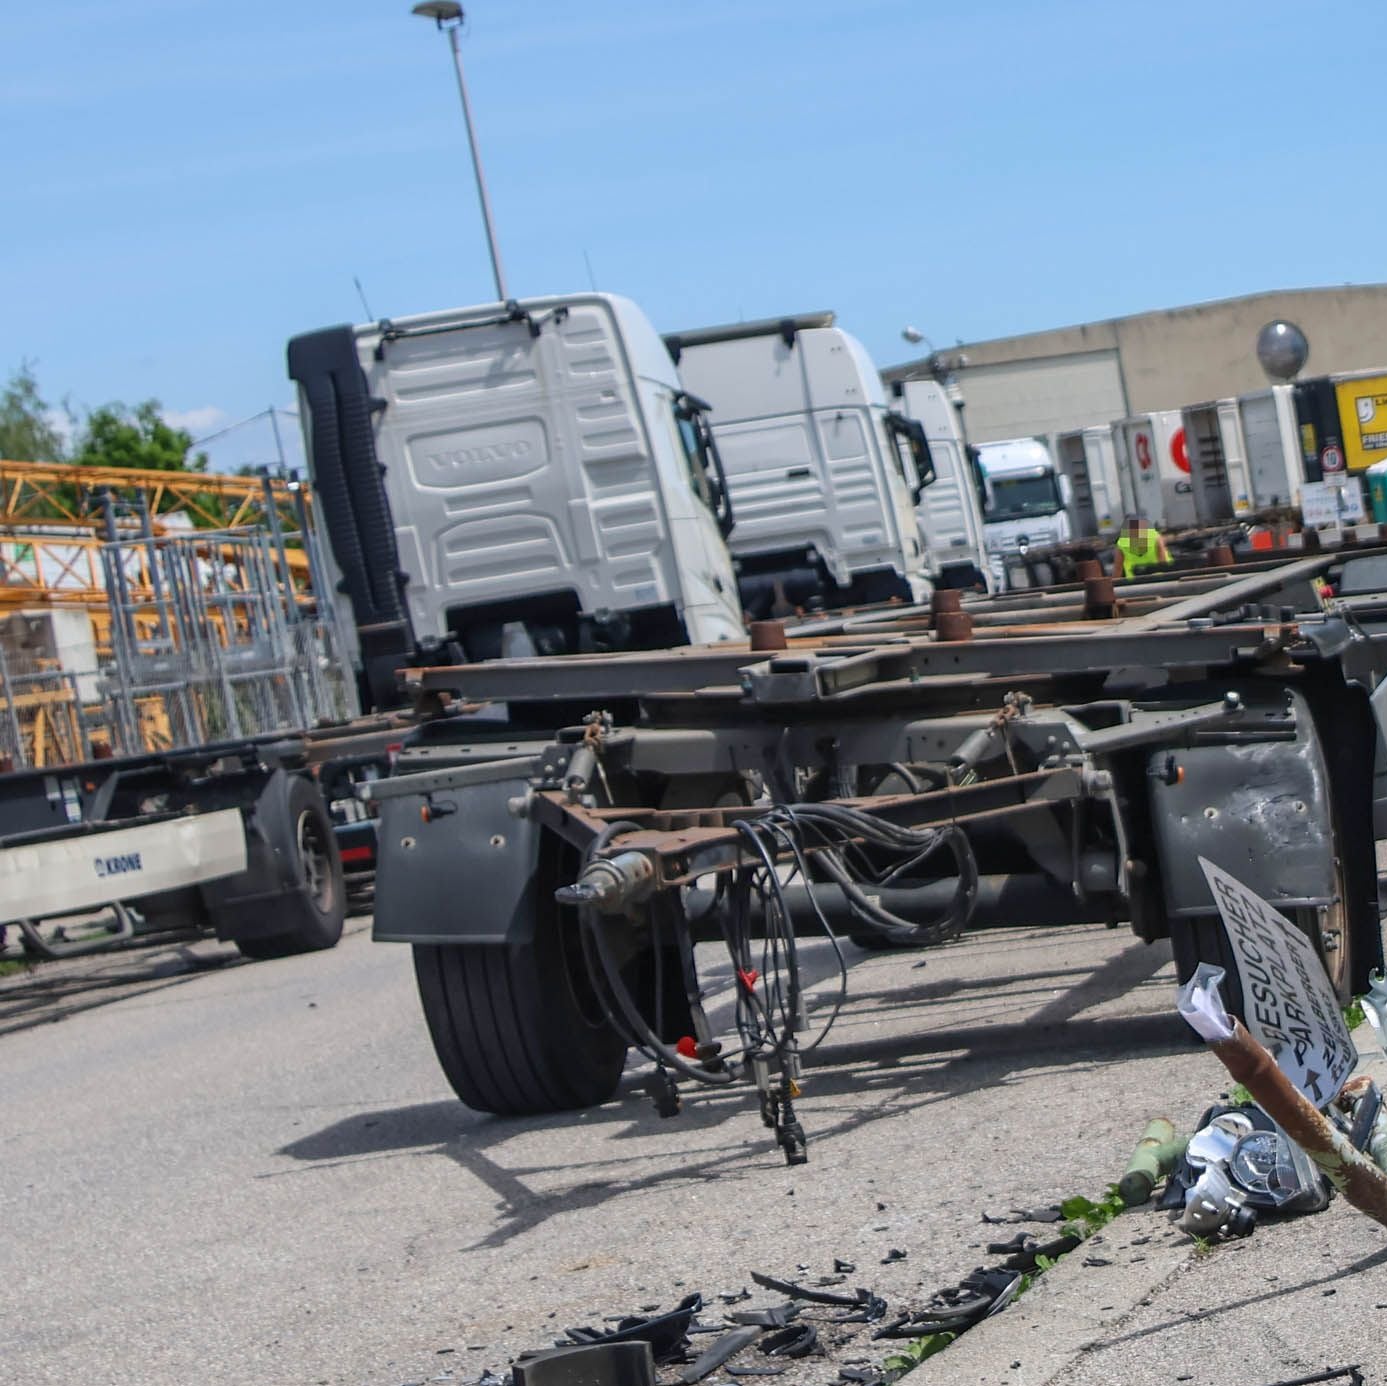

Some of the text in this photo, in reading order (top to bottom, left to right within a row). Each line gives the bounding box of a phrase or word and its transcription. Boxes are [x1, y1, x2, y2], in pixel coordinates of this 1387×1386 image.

[425, 440, 530, 471] VOLVO
[106, 852, 142, 875] KRONE
[1213, 876, 1291, 1044] BESUCHER
[1244, 897, 1314, 1066] PARKPLATZ
